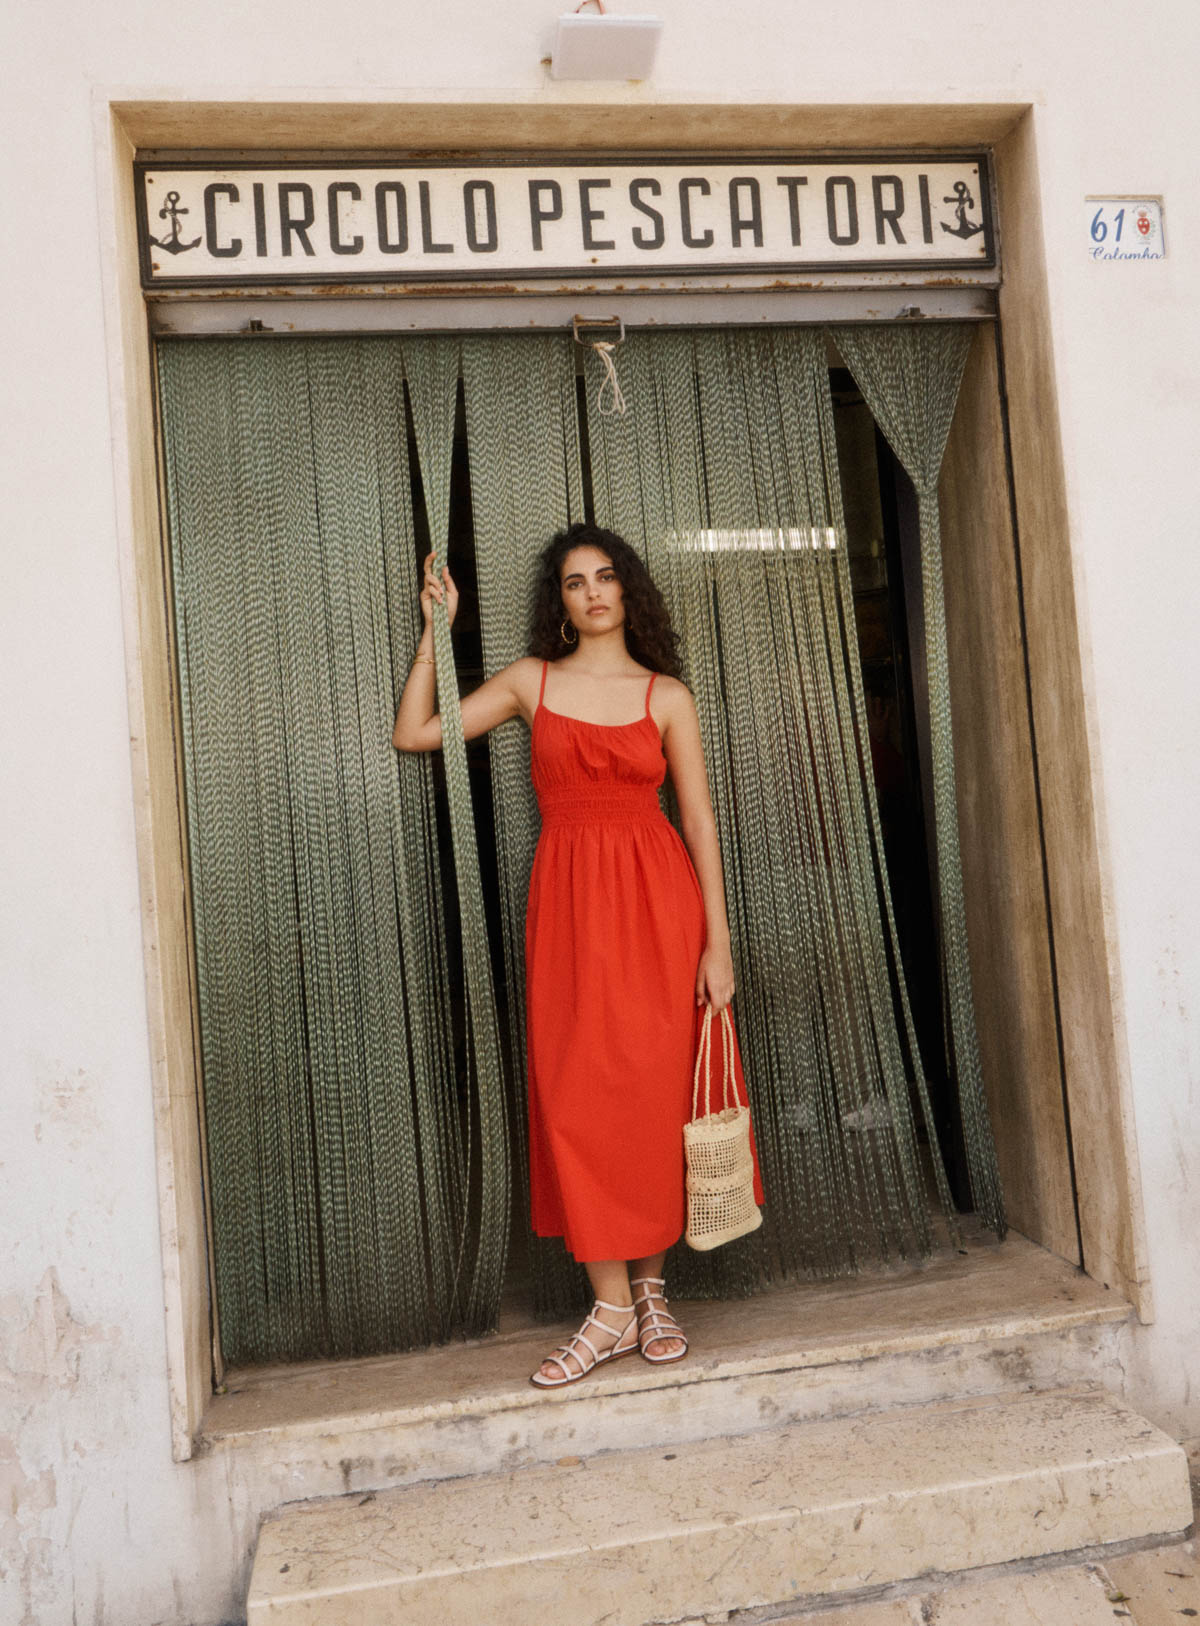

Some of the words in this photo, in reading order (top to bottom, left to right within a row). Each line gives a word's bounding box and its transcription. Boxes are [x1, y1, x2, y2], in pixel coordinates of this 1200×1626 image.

[203, 180, 499, 258] CIRCOLO
[528, 175, 933, 251] PESCATORI
[1090, 207, 1125, 243] 61
